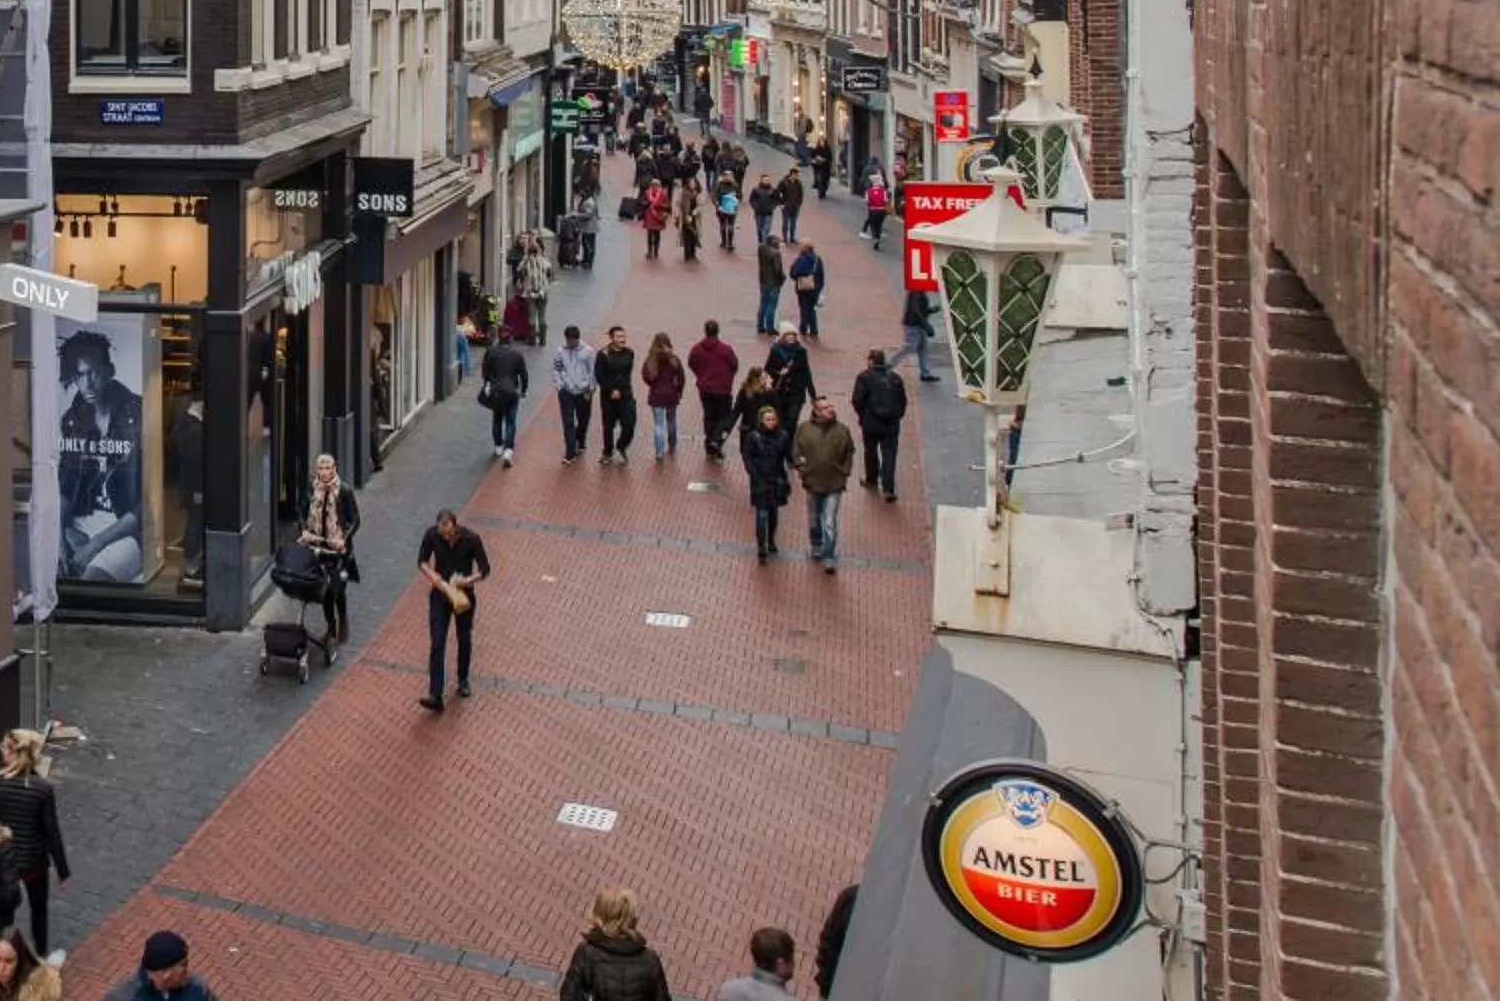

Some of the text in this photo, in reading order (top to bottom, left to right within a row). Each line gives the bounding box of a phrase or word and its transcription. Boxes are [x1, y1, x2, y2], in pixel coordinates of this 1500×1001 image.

[357, 194, 407, 212] SONS
[912, 197, 985, 210] TAX FRE
[12, 277, 69, 309] ONLY
[99, 440, 132, 454] SONS
[973, 846, 1085, 882] AMSTEL
[997, 882, 1058, 907] BIER
